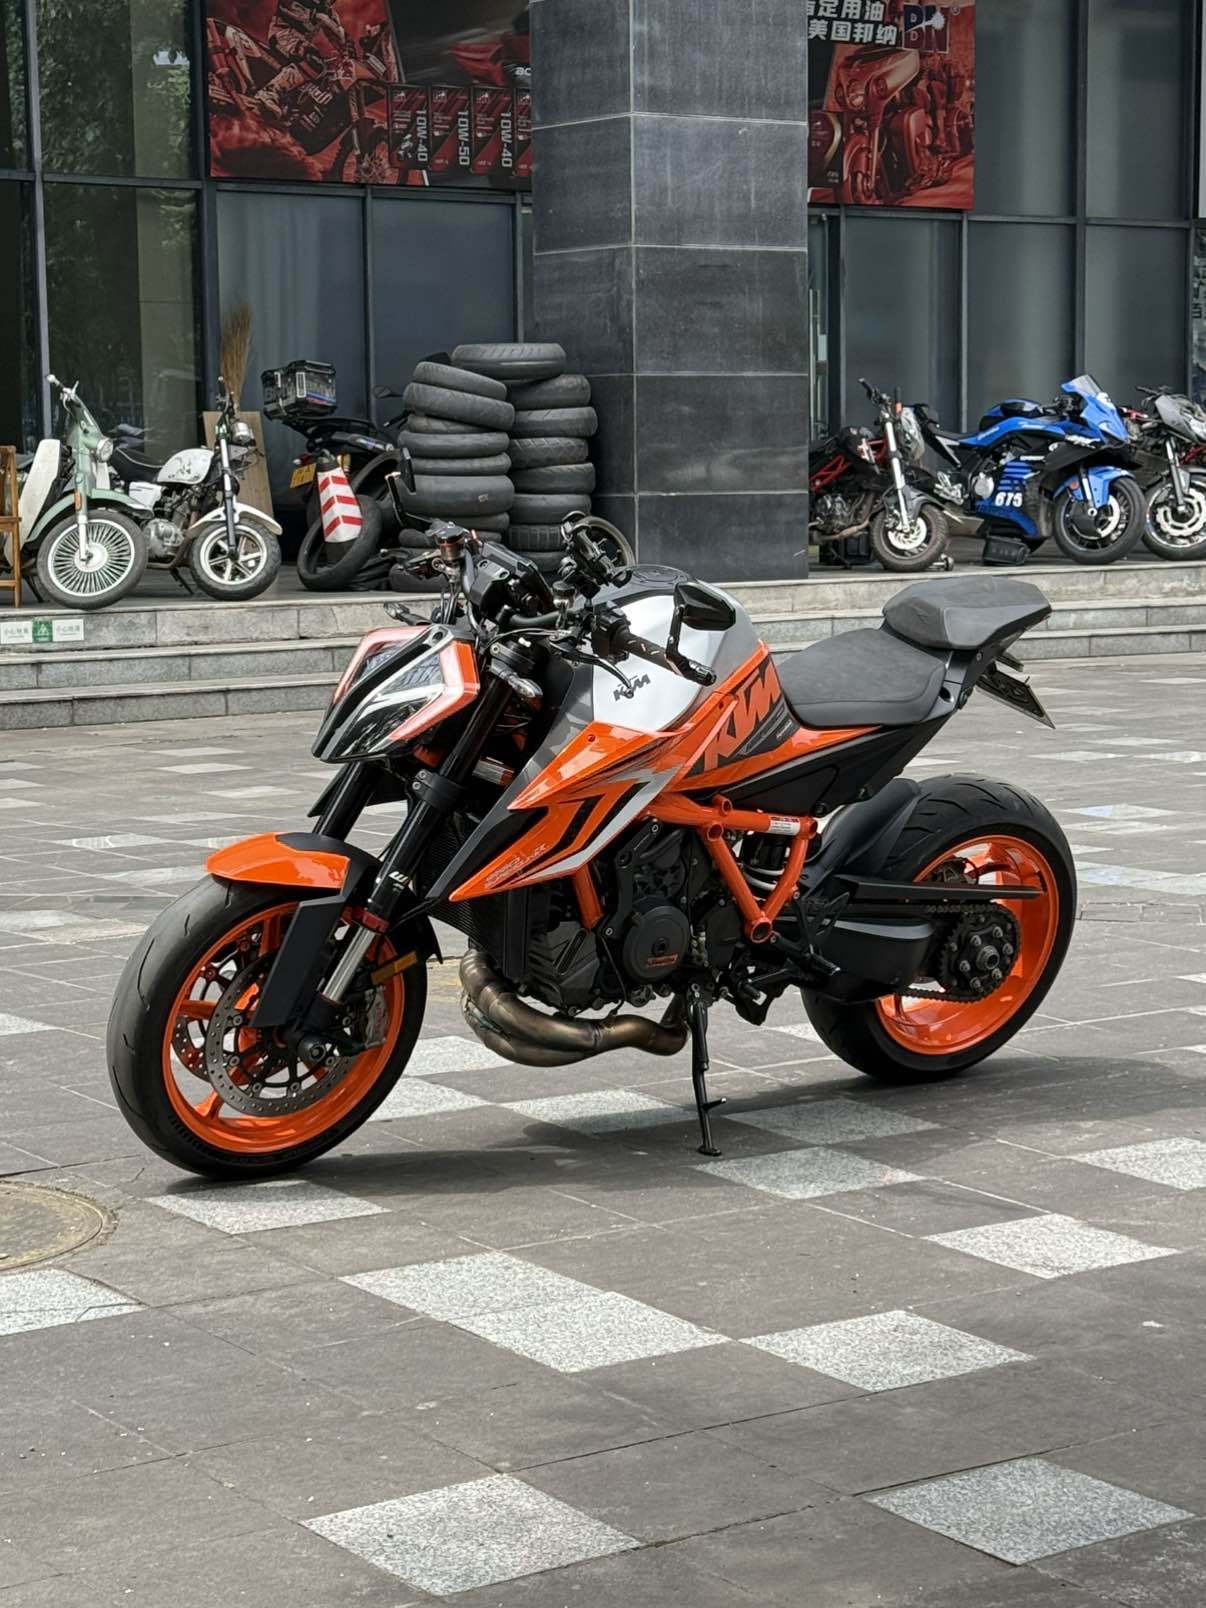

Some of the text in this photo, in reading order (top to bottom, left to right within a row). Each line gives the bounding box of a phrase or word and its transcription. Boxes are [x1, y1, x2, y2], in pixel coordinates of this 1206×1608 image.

[808, 19, 897, 45] 美国邦纳
[416, 110, 428, 162] 10W-40
[457, 111, 470, 166] 10W-50
[501, 112, 513, 167] 10W-40
[995, 491, 1023, 508] 675
[704, 658, 782, 772] KTM
